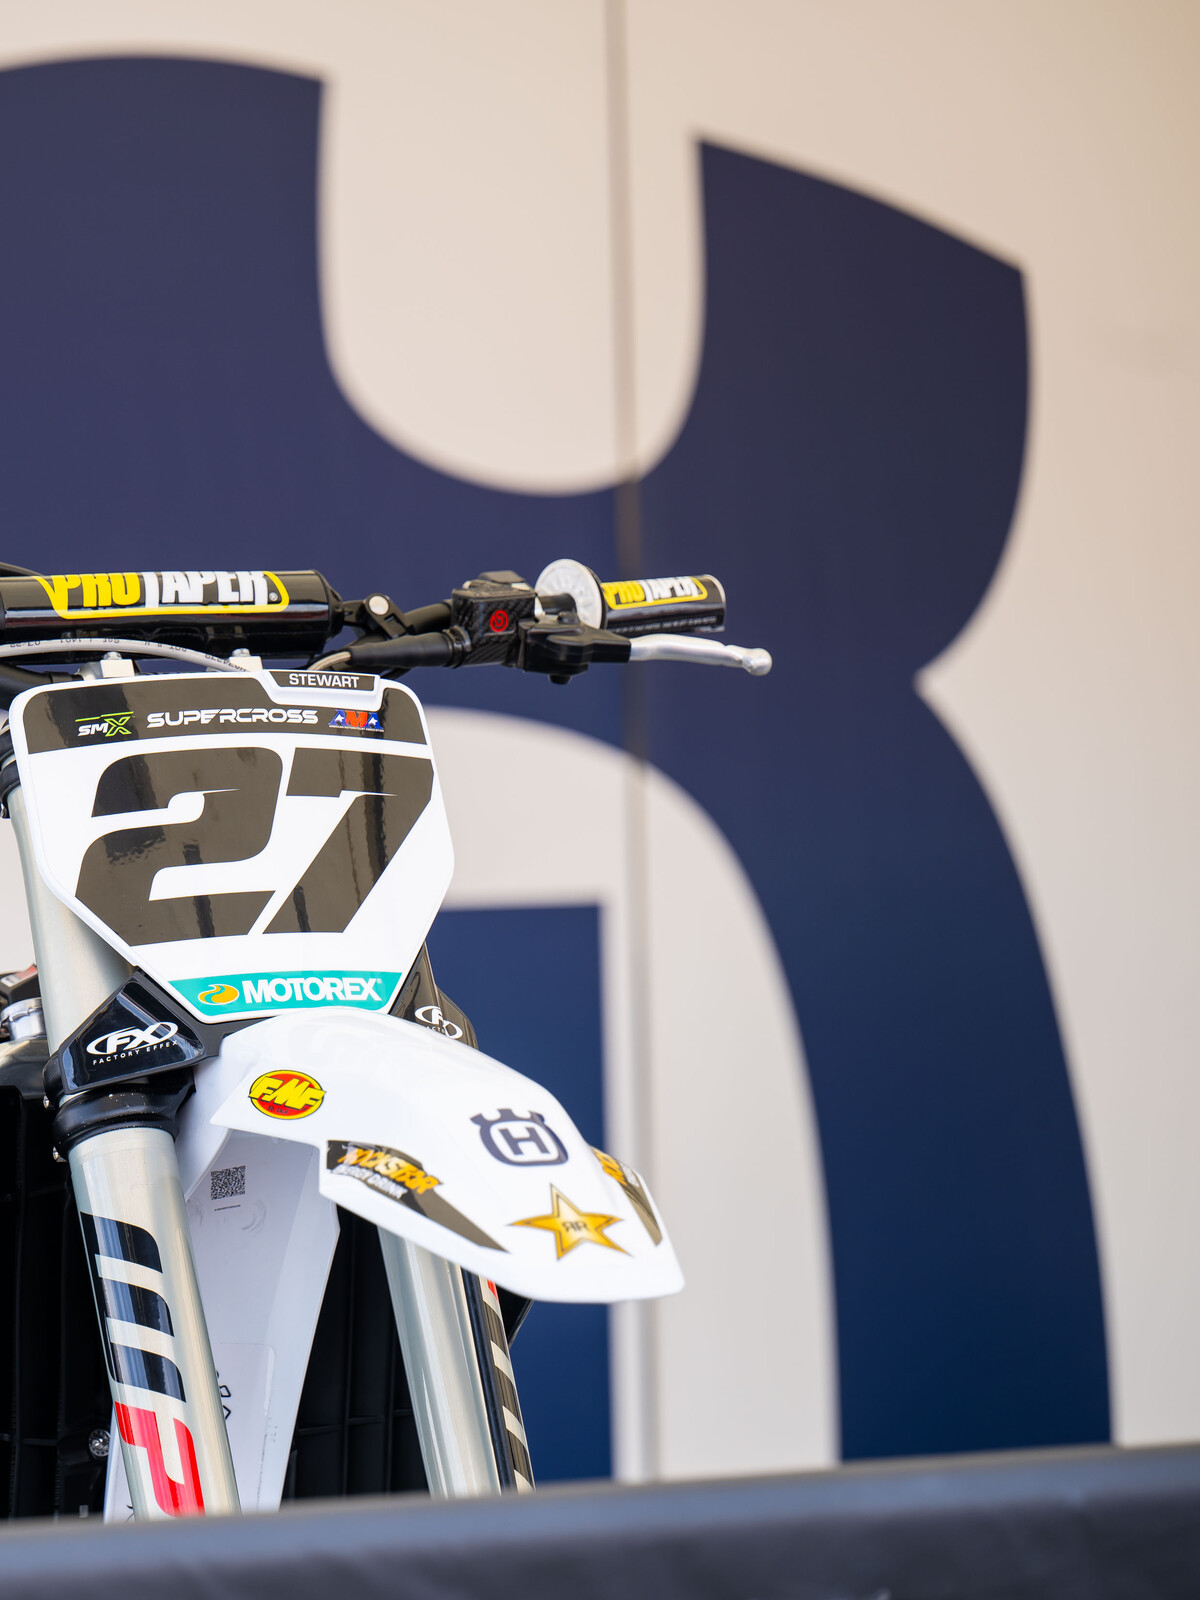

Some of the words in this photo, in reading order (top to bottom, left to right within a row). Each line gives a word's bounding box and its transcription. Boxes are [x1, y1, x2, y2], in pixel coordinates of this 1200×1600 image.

[289, 673, 360, 689] STEWART
[77, 715, 133, 738] SMX
[146, 708, 319, 729] SUPERCROSS
[328, 709, 384, 730] AMA
[74, 746, 435, 947] 27
[242, 977, 382, 1004] MOTOREX
[92, 1049, 141, 1066] FACTORY
[146, 1039, 179, 1053] EFFEX
[248, 1076, 327, 1111] FMF
